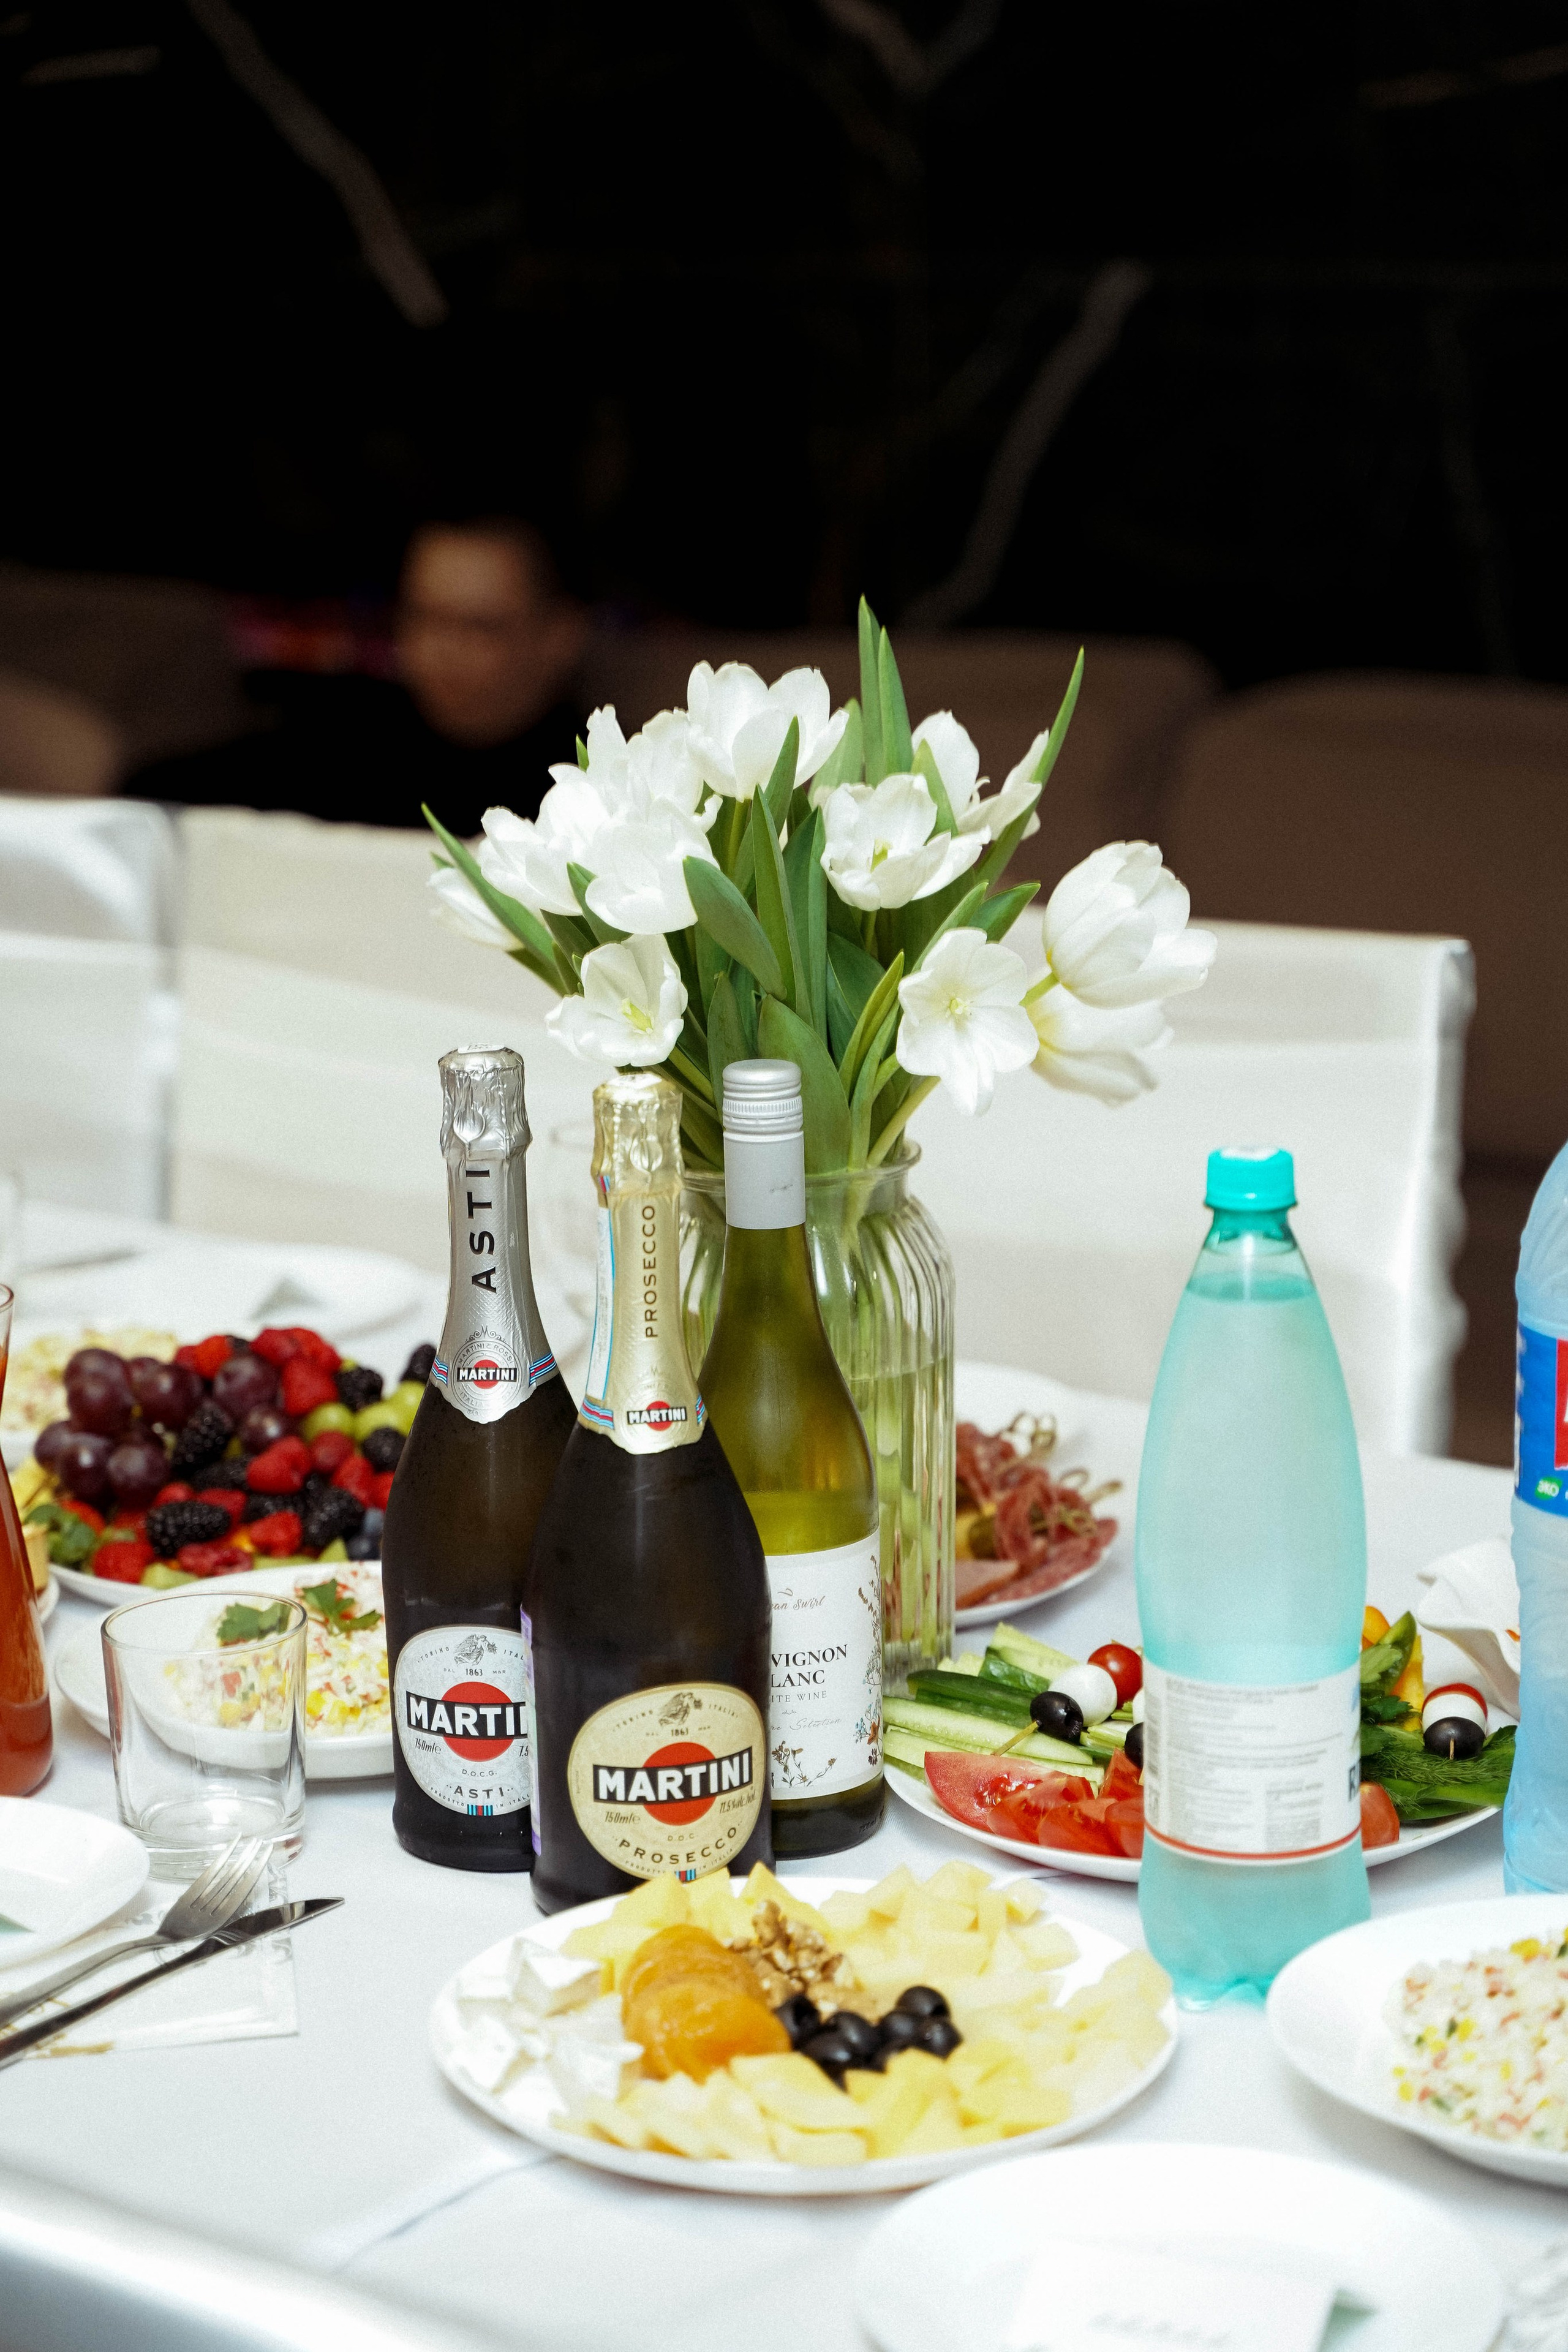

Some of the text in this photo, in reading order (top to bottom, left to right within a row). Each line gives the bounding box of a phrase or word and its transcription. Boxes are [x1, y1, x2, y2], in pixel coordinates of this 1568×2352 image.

[466, 1169, 497, 1294] ASTI
[642, 1205, 658, 1338] PROSECCO
[458, 1343, 485, 1365] MARTINI
[494, 1344, 514, 1365] ROSSI
[459, 1368, 514, 1381] MARTINI
[628, 1408, 686, 1425] MARTINI
[420, 1646, 524, 1662] TORINO ITAL
[771, 1643, 848, 1668] VIGNON
[466, 1668, 483, 1676] 1863
[771, 1669, 825, 1688] LANC
[771, 1690, 827, 1703] ITE WINE
[462, 1768, 497, 1777] D.O.C.G.
[598, 1751, 749, 1802] MARTINI
[430, 1787, 465, 1807] PRODOTTO
[509, 1793, 530, 1805] ITALI
[454, 1785, 505, 1800] ASTI
[619, 1826, 737, 1864] PROSECCO
